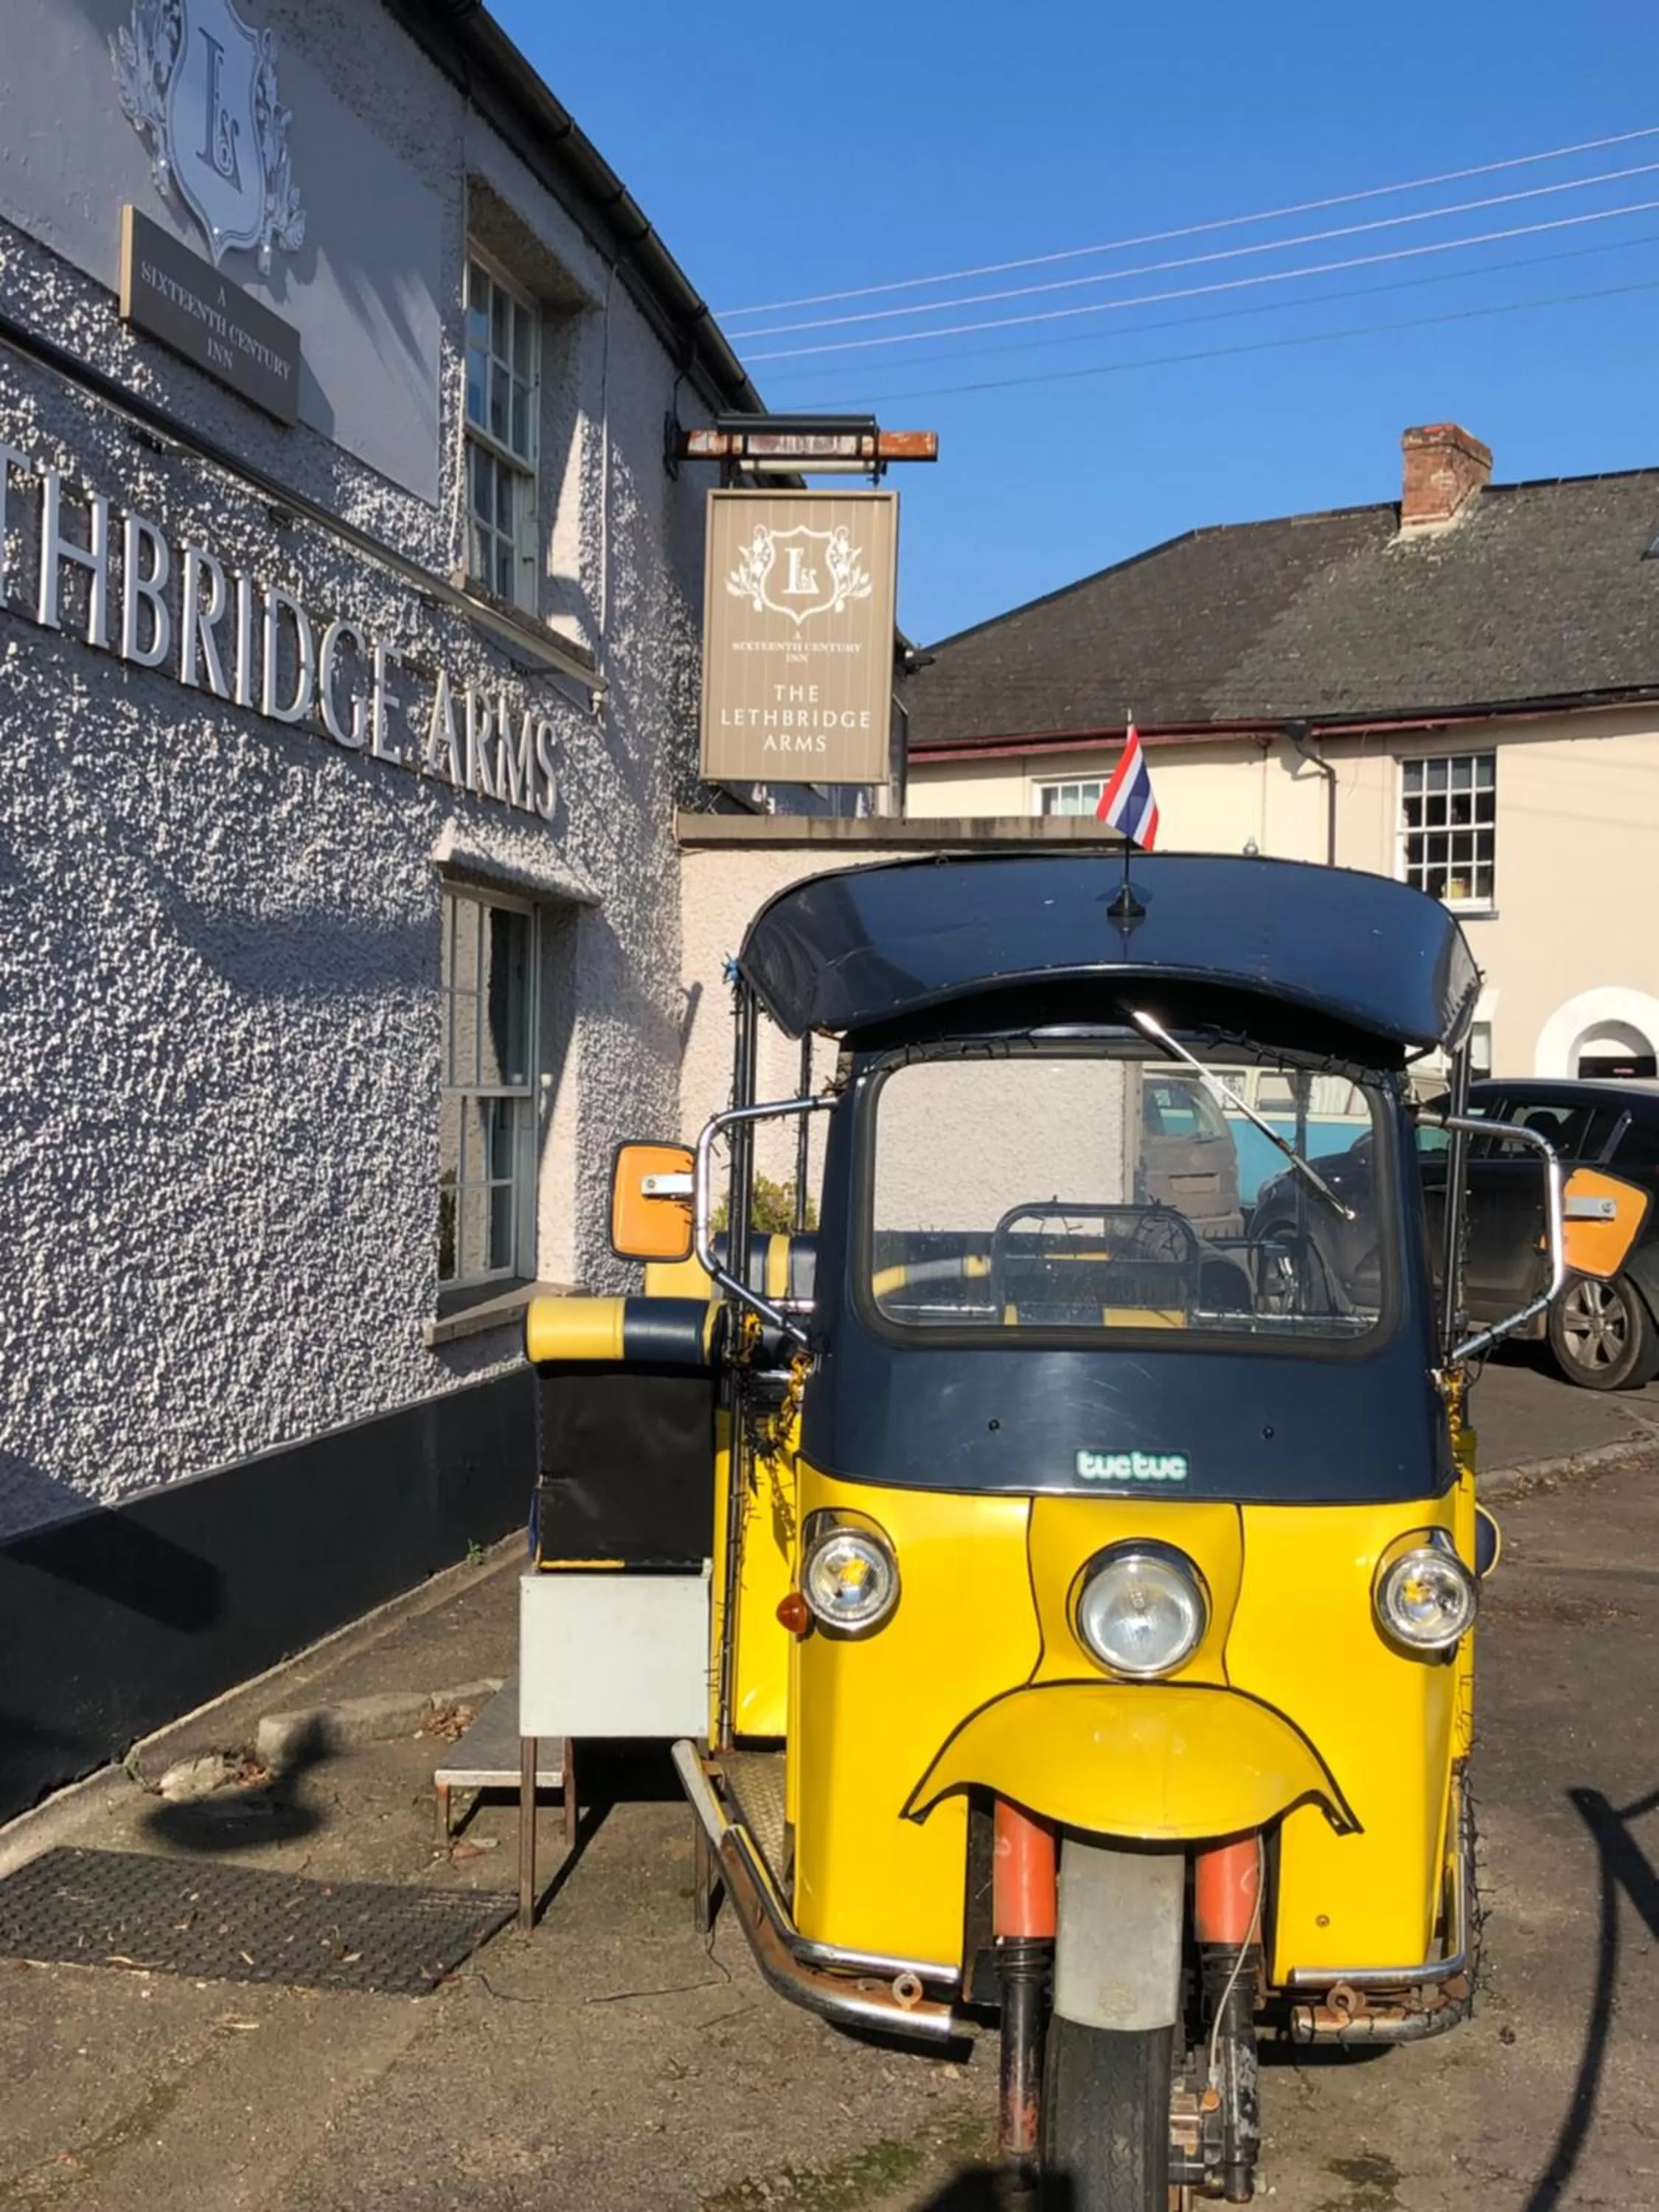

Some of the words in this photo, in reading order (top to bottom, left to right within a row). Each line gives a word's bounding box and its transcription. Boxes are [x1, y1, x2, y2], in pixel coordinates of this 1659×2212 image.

[217, 285, 226, 307] A
[141, 260, 227, 338] SIXTEENTH
[229, 323, 291, 381] CENTURY
[206, 336, 234, 369] INN
[792, 630, 802, 641] A
[731, 641, 803, 652] SIXTEENTH
[804, 641, 861, 653] CENTURY
[785, 653, 810, 664] INN
[773, 684, 820, 703] THE
[720, 708, 872, 729] LETHBRIDGE
[425, 669, 557, 821] ARMS
[763, 734, 827, 753] ARMS
